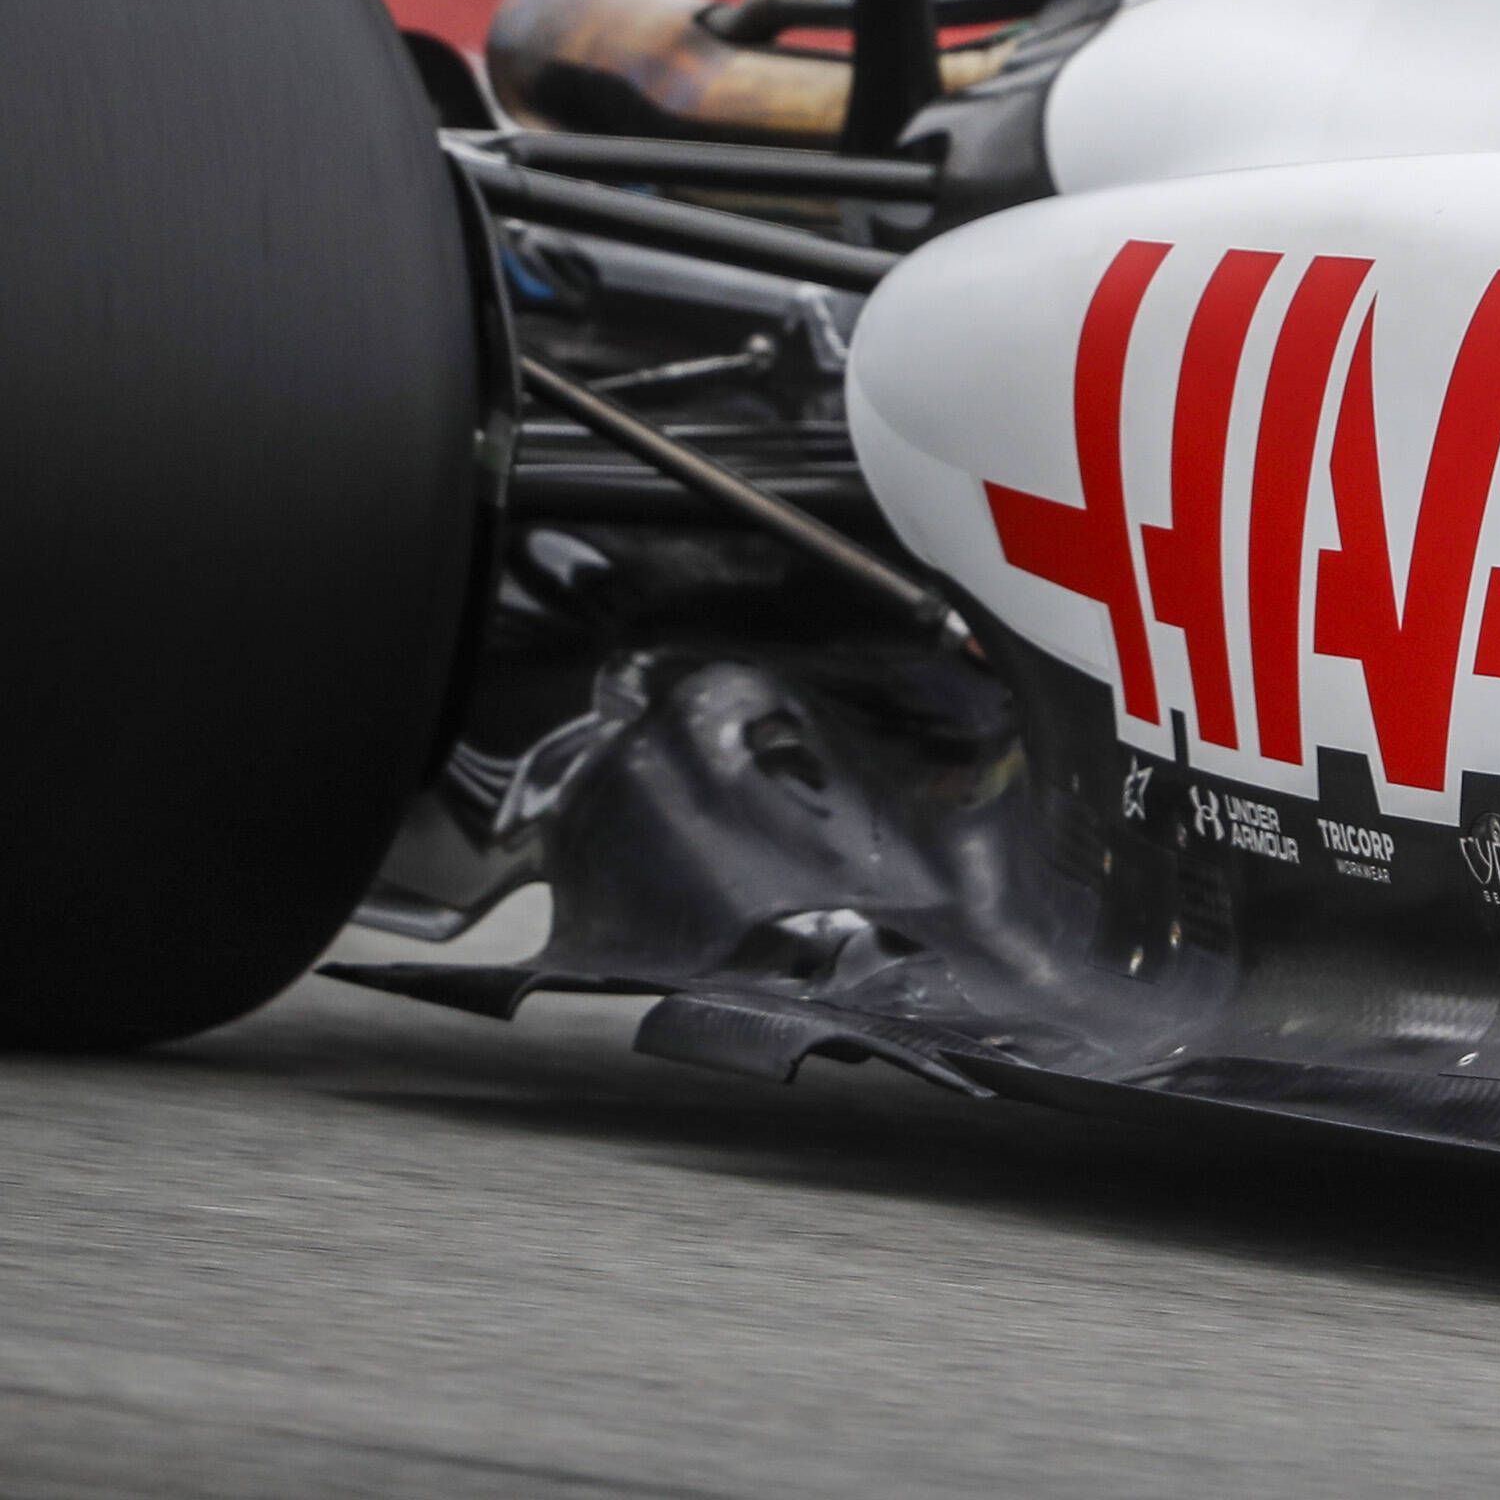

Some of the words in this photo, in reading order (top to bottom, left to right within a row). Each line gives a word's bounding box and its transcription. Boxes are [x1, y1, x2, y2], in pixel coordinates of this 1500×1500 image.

[1224, 794, 1281, 833] UNDER
[1231, 822, 1300, 864] ARMOUR
[1316, 818, 1395, 862] TRICORP
[1335, 857, 1392, 884] WORKWEAR
